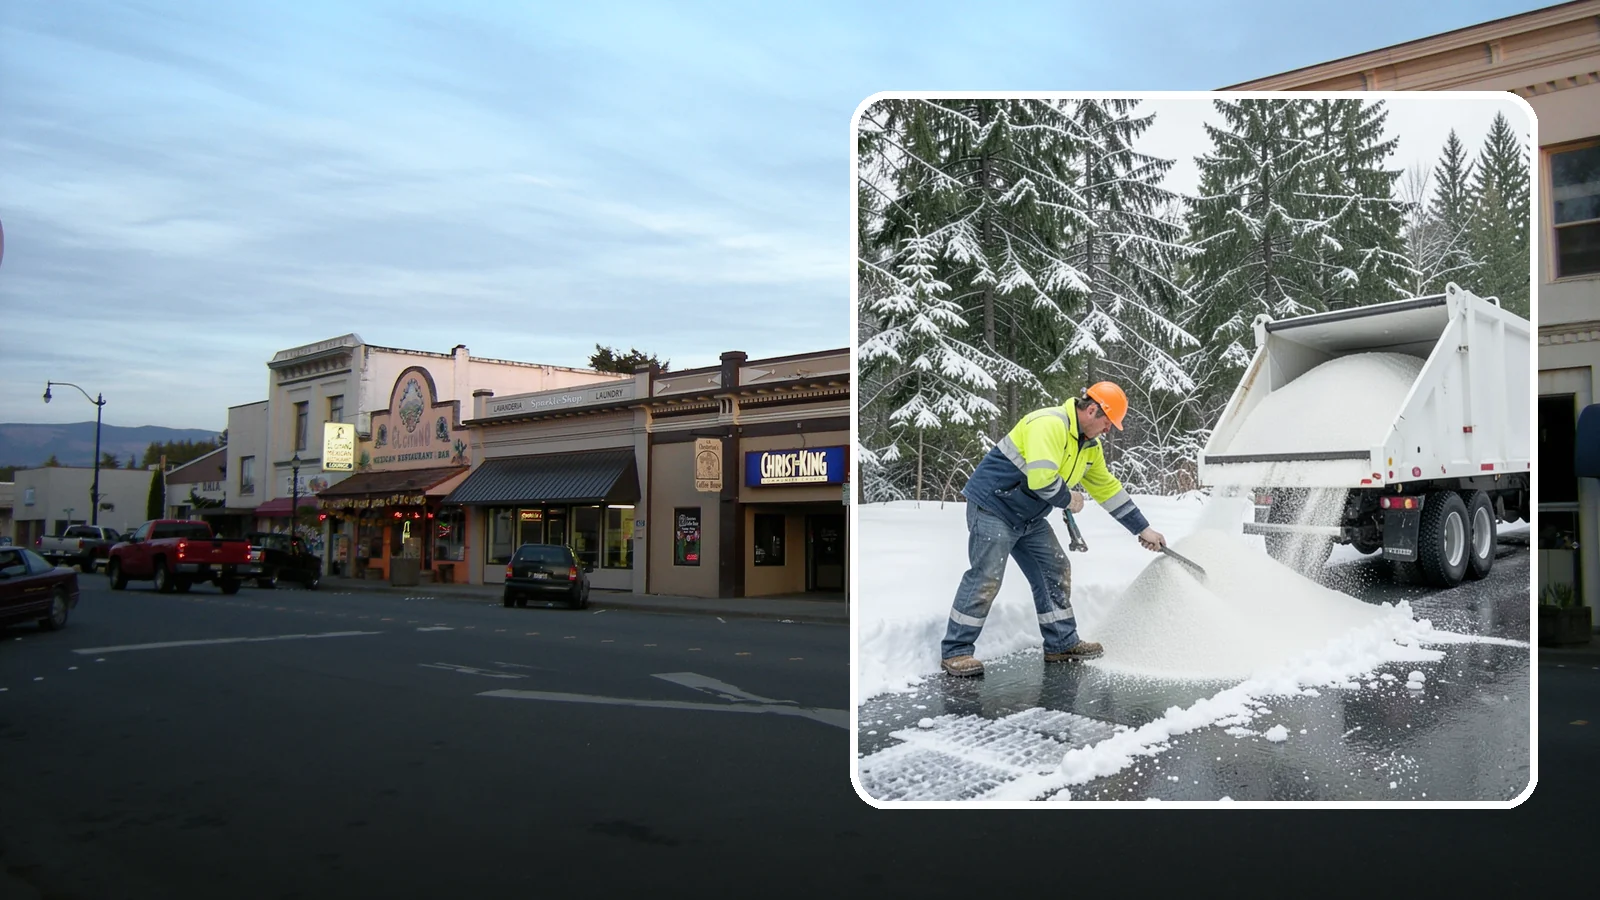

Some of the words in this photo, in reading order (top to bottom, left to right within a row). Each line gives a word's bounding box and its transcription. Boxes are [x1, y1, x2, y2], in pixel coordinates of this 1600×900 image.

[493, 402, 523, 413] LAVANDERIA
[530, 396, 561, 409] Sparkle
[561, 394, 583, 405] Shop
[595, 389, 624, 400] LAUNDRY
[373, 455, 396, 463] MEXICAN
[398, 452, 433, 462] RESTAURANT
[438, 451, 450, 459] BAR
[761, 452, 797, 478] CHRIST
[799, 449, 828, 477] KING
